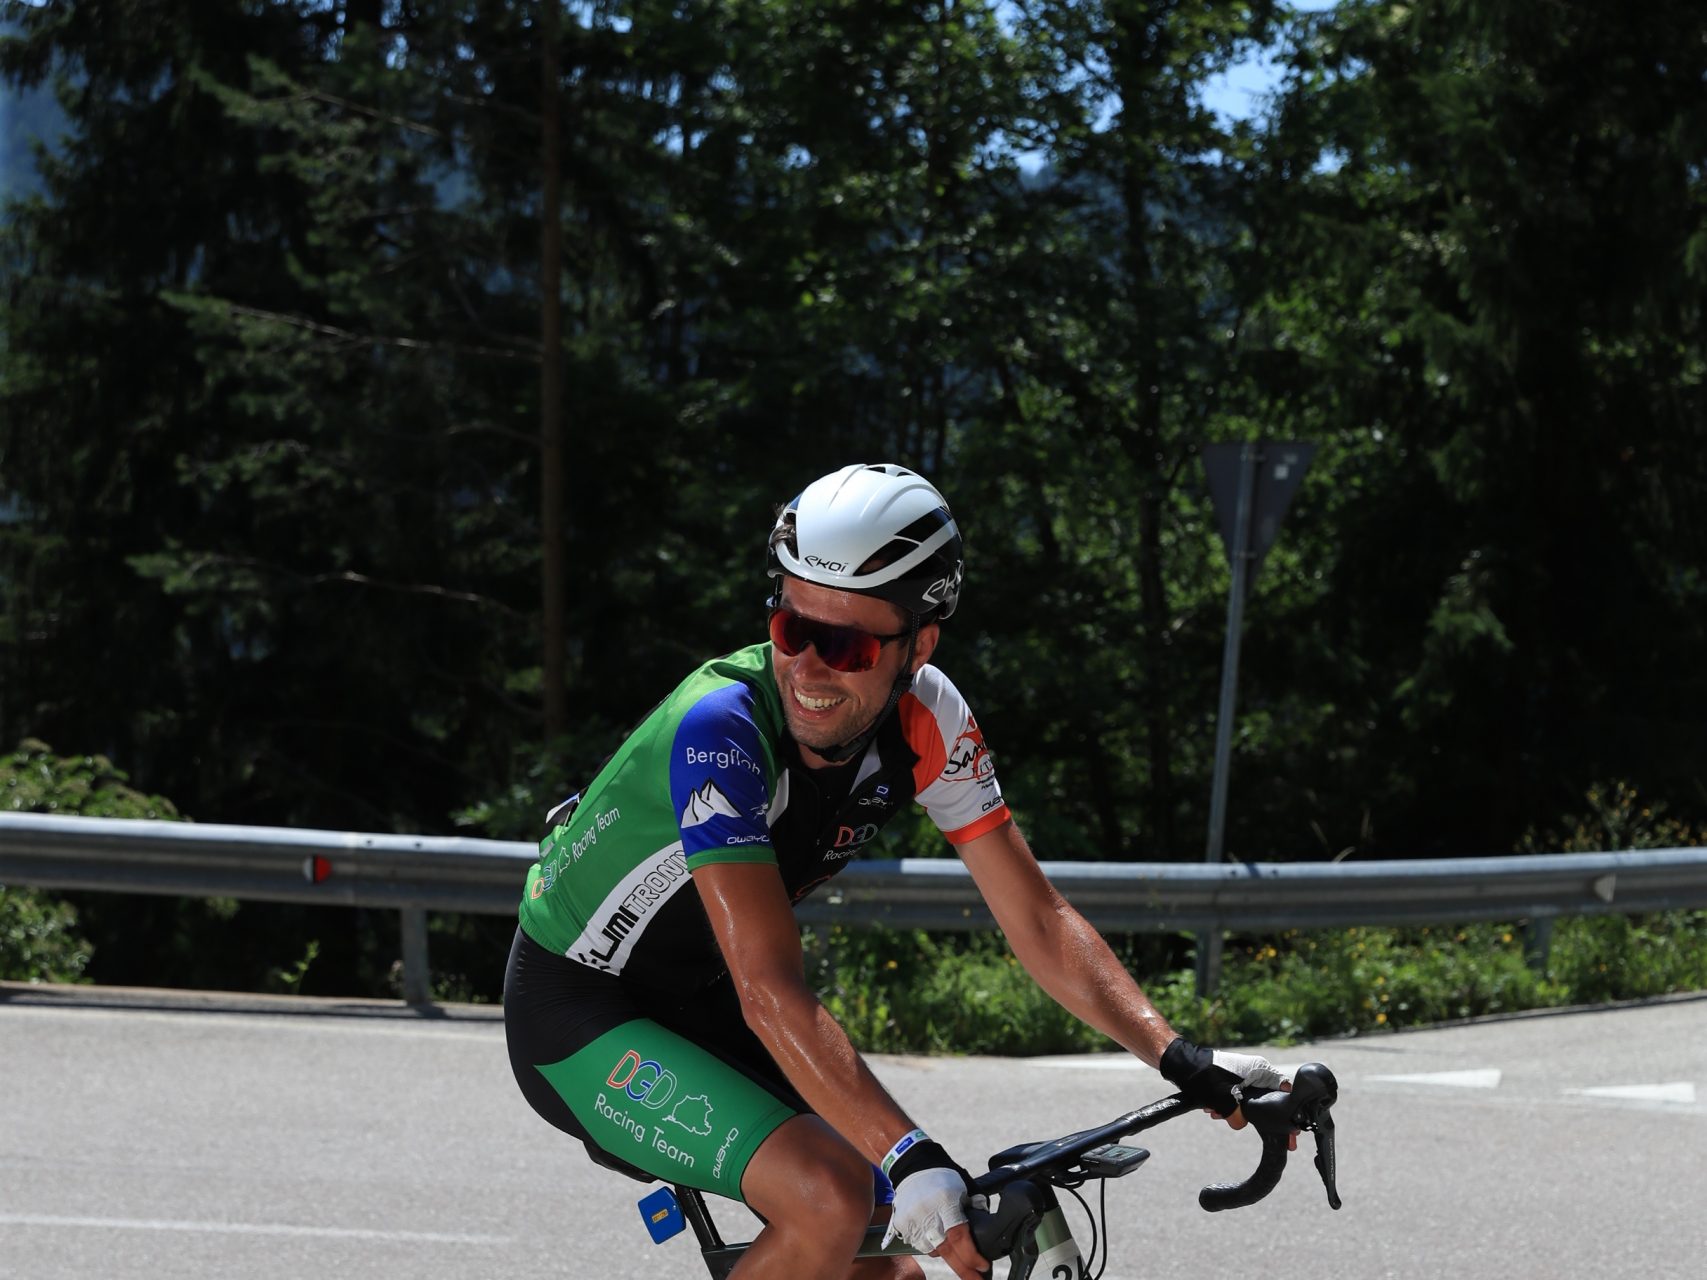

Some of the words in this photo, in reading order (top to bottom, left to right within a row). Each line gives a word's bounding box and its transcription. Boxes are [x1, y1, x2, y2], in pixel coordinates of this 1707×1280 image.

[571, 826, 597, 863] Racing
[595, 807, 621, 833] Team
[605, 1049, 678, 1110] DGD
[594, 1092, 646, 1143] Racing
[650, 1126, 695, 1168] Team
